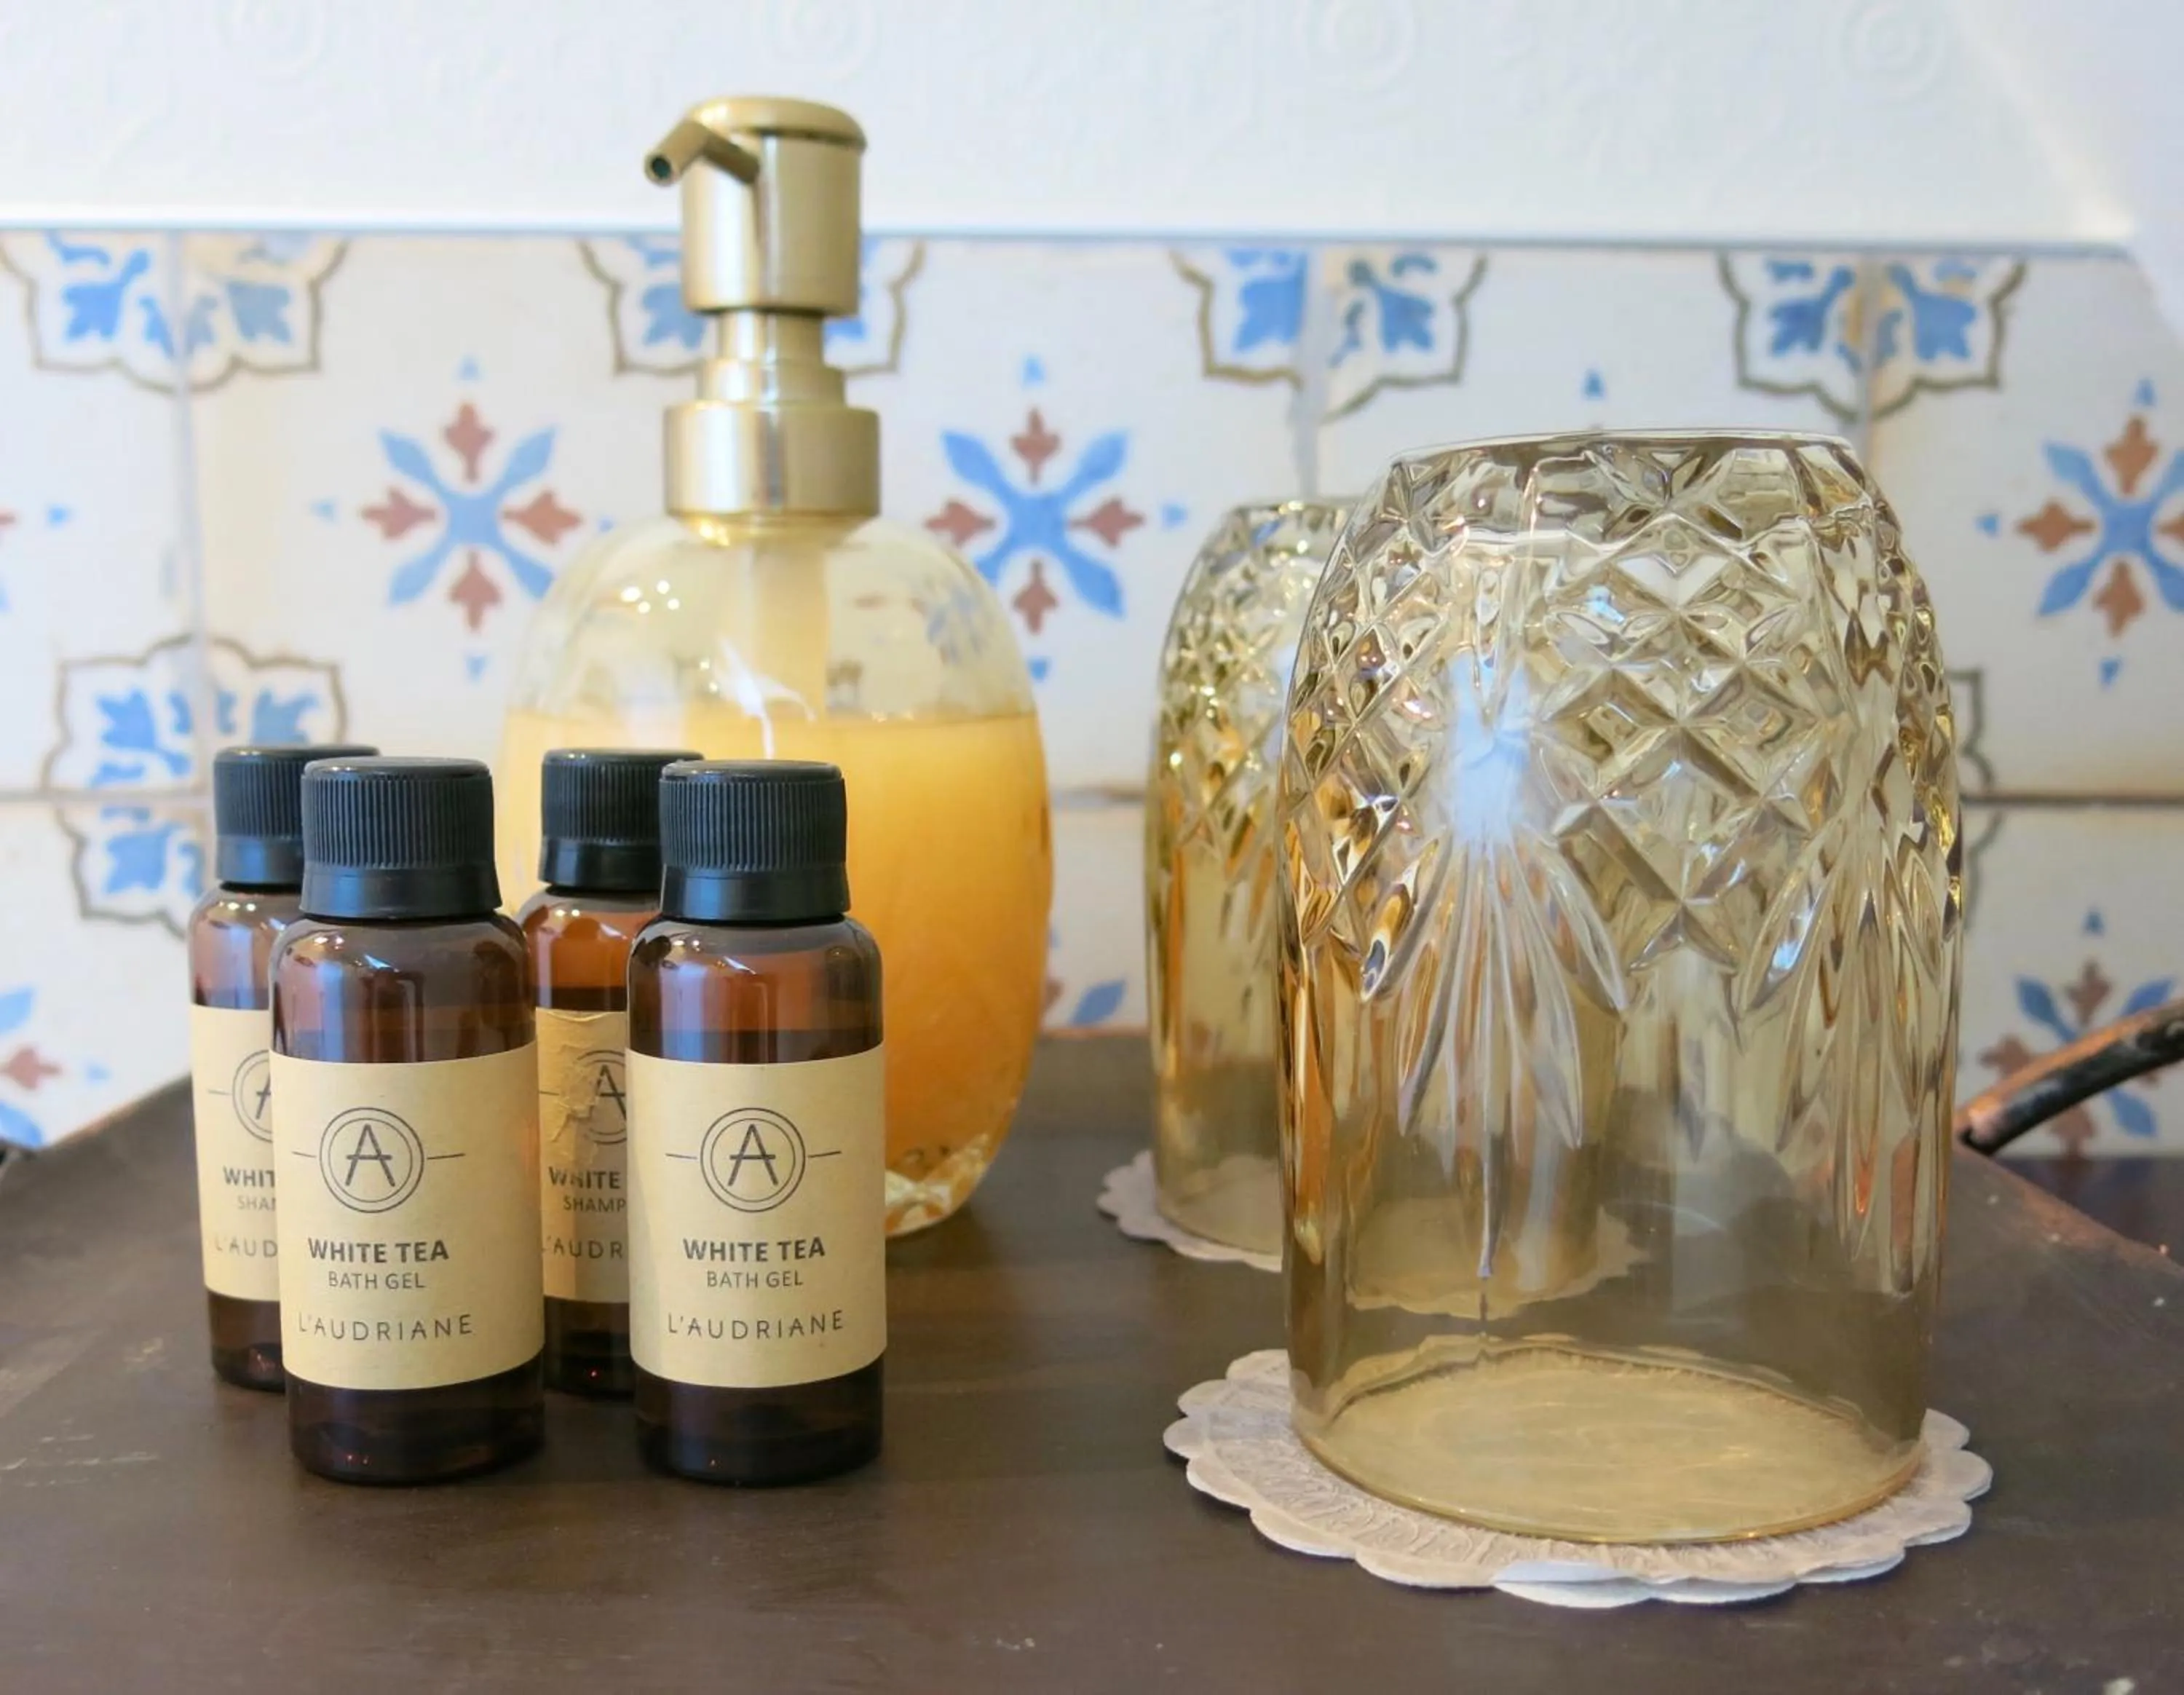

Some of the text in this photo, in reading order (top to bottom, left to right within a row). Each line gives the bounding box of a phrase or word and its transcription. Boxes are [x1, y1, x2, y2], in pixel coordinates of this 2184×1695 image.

[237, 1195, 276, 1212] SHA
[308, 1238, 449, 1263] WHITE TEA
[683, 1236, 826, 1263] WHITE TEA
[328, 1271, 426, 1289] BATH GEL
[707, 1270, 804, 1288] BATH GEL
[298, 1311, 473, 1341] L'AUDRIANE
[668, 1310, 844, 1340] L'AUDRIANE
